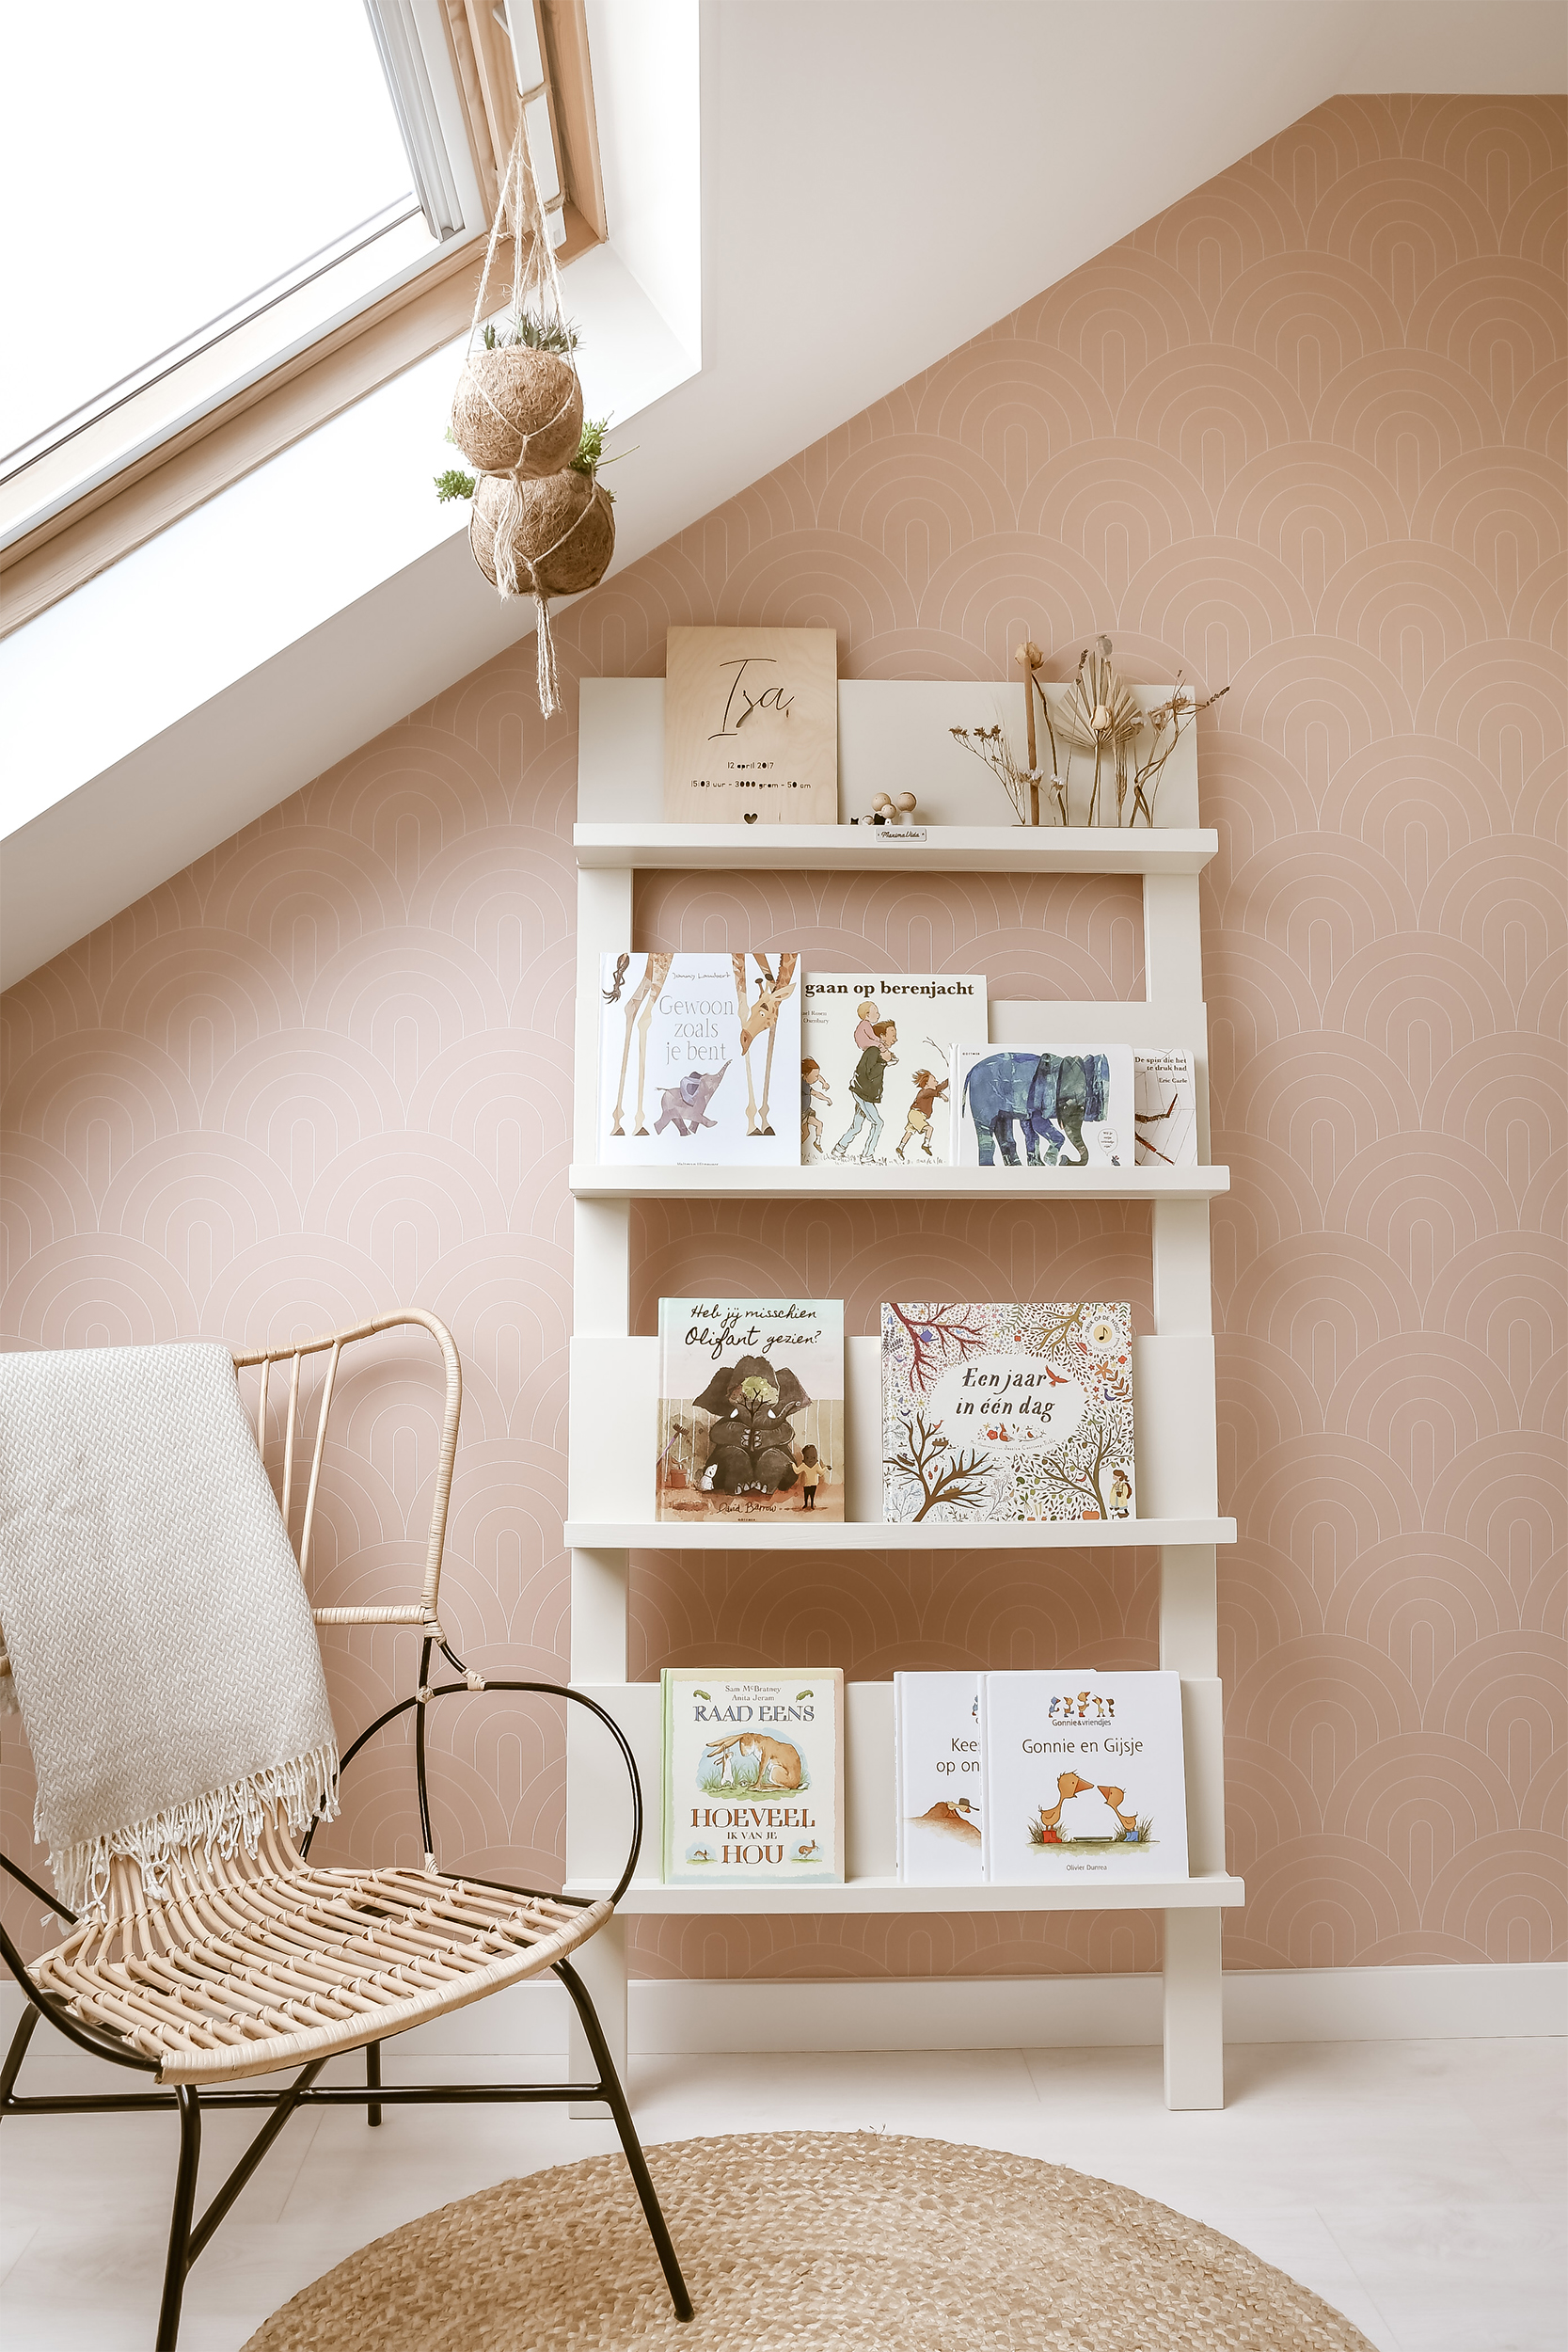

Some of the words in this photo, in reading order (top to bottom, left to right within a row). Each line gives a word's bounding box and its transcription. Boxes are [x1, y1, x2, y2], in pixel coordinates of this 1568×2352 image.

[707, 659, 795, 740] Isa
[727, 761, 735, 770] 12
[736, 761, 755, 771] april
[757, 761, 774, 770] 2017
[804, 983, 848, 997] gaan
[853, 984, 876, 997] op
[880, 981, 974, 999] berenjacht
[659, 995, 735, 1015] Gewoon
[674, 1018, 719, 1038] zoals
[666, 1041, 681, 1065] je
[687, 1041, 726, 1060] bent
[690, 1303, 721, 1318] Heb
[745, 1304, 816, 1319] misschien
[1111, 1318, 1120, 1333] NOOT
[685, 1326, 761, 1360] Olifant
[762, 1330, 822, 1354] gezien?
[961, 1367, 1000, 1387] Een
[992, 1369, 1047, 1395] jaar
[956, 1397, 974, 1414] in
[980, 1397, 1013, 1414] één
[1019, 1395, 1055, 1422] dag
[716, 1502, 743, 1514] David
[744, 1502, 777, 1513] Barrow
[692, 1705, 753, 1723] RAAD
[758, 1705, 816, 1723] EENS
[952, 1738, 980, 1752] Kee
[1022, 1739, 1075, 1754] Gonnie
[1080, 1741, 1099, 1753] en
[1103, 1737, 1144, 1756] Gijsje
[936, 1761, 956, 1776] op
[961, 1761, 980, 1772] on
[689, 1808, 816, 1828] HOEVEEL
[727, 1832, 737, 1840] IK
[740, 1832, 763, 1840] VAN
[766, 1832, 778, 1840] JE
[721, 1844, 784, 1865] HOU
